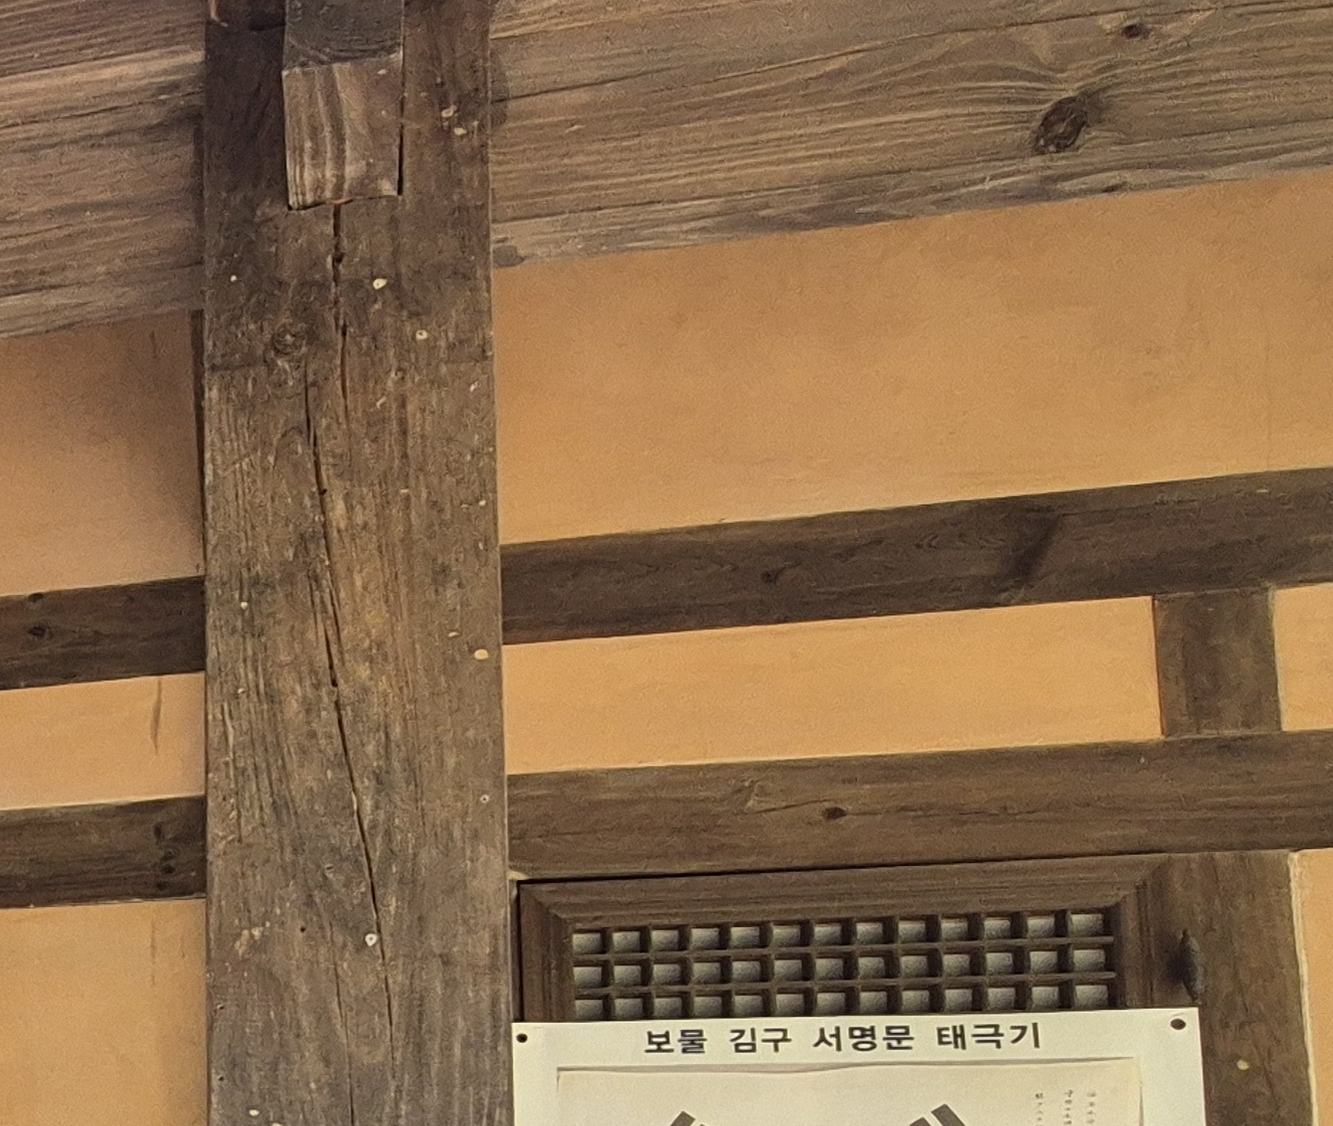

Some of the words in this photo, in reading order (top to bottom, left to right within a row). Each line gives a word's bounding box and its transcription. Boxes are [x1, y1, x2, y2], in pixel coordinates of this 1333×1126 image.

[644, 1028, 708, 1054] 보물
[729, 1027, 792, 1053] 김구
[813, 1025, 915, 1052] 서명문
[936, 1022, 1041, 1050] 태극기
